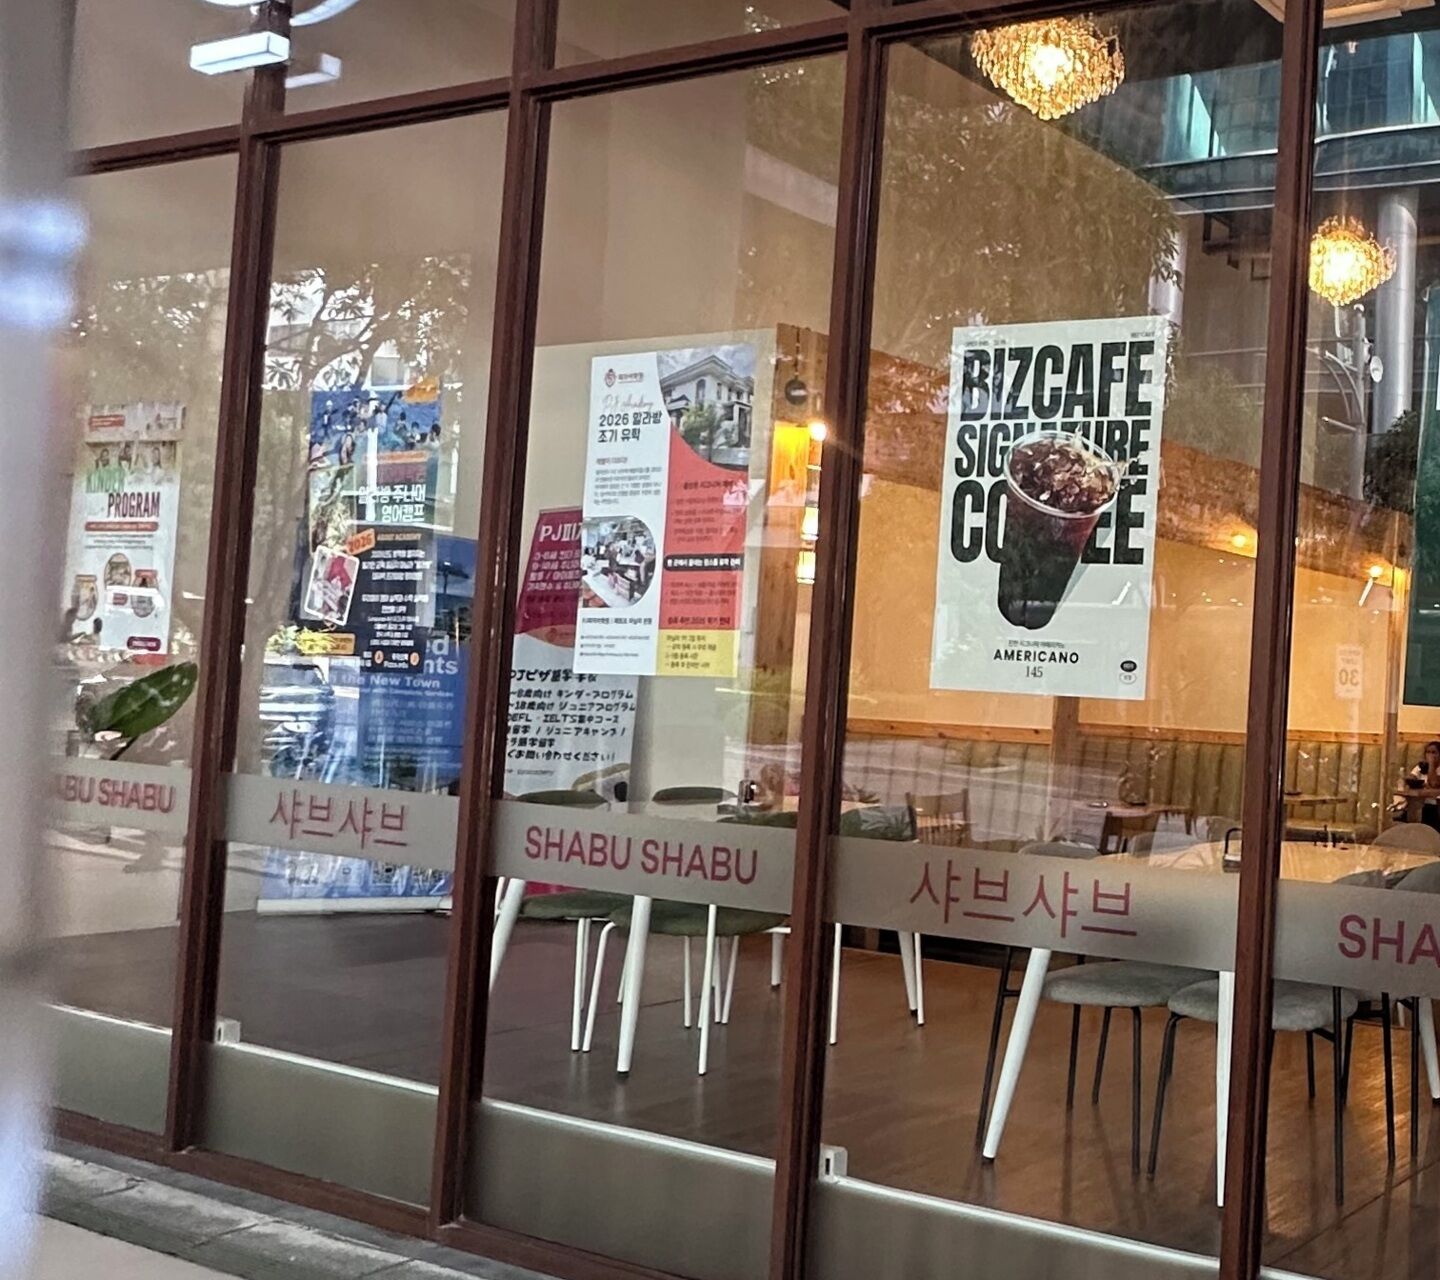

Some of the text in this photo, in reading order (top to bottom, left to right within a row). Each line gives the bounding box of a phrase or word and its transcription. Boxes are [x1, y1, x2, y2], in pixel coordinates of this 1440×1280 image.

[960, 340, 1155, 421] BIZCAFE
[599, 412, 629, 427] 2026
[597, 428, 618, 443] 조기
[107, 491, 161, 519] PROGRAM
[347, 534, 373, 555] 2026
[994, 648, 1079, 664] AMERICANO
[370, 671, 441, 689] New Town
[1026, 665, 1044, 678] 145
[98, 777, 176, 814] SHABU
[269, 790, 408, 850] 샤브샤브
[524, 825, 759, 885] SHABU SHABU
[909, 859, 1138, 939] 샤브샤브
